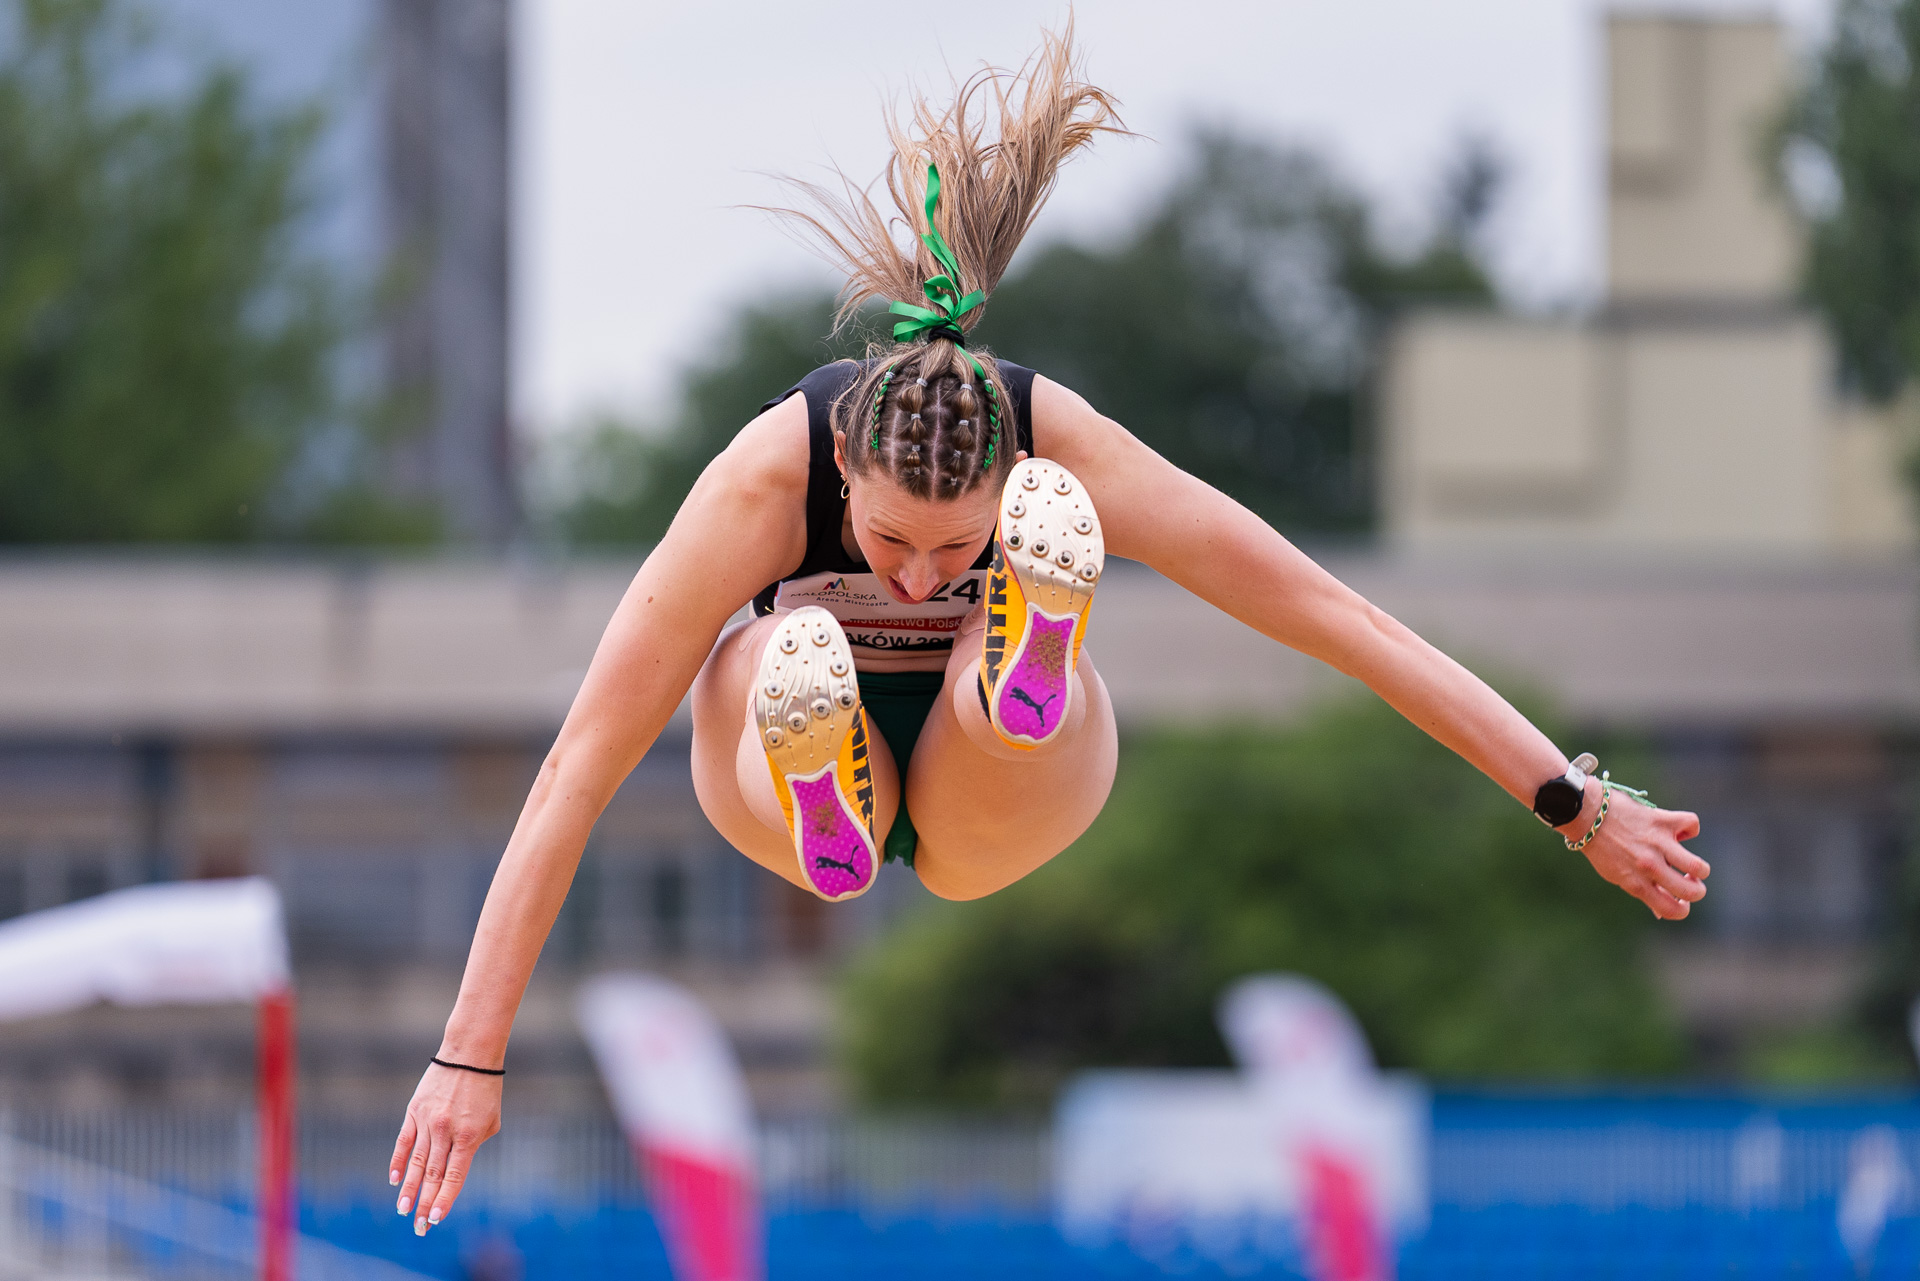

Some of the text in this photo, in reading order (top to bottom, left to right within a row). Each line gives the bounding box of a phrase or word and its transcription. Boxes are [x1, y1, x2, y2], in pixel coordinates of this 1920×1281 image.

[791, 591, 877, 601] MAŁOPOLSKA
[845, 616, 963, 629] strzostwa Polsk
[986, 541, 1006, 690] NITRO
[845, 631, 911, 647] AKÓW
[852, 707, 875, 845] NITR
